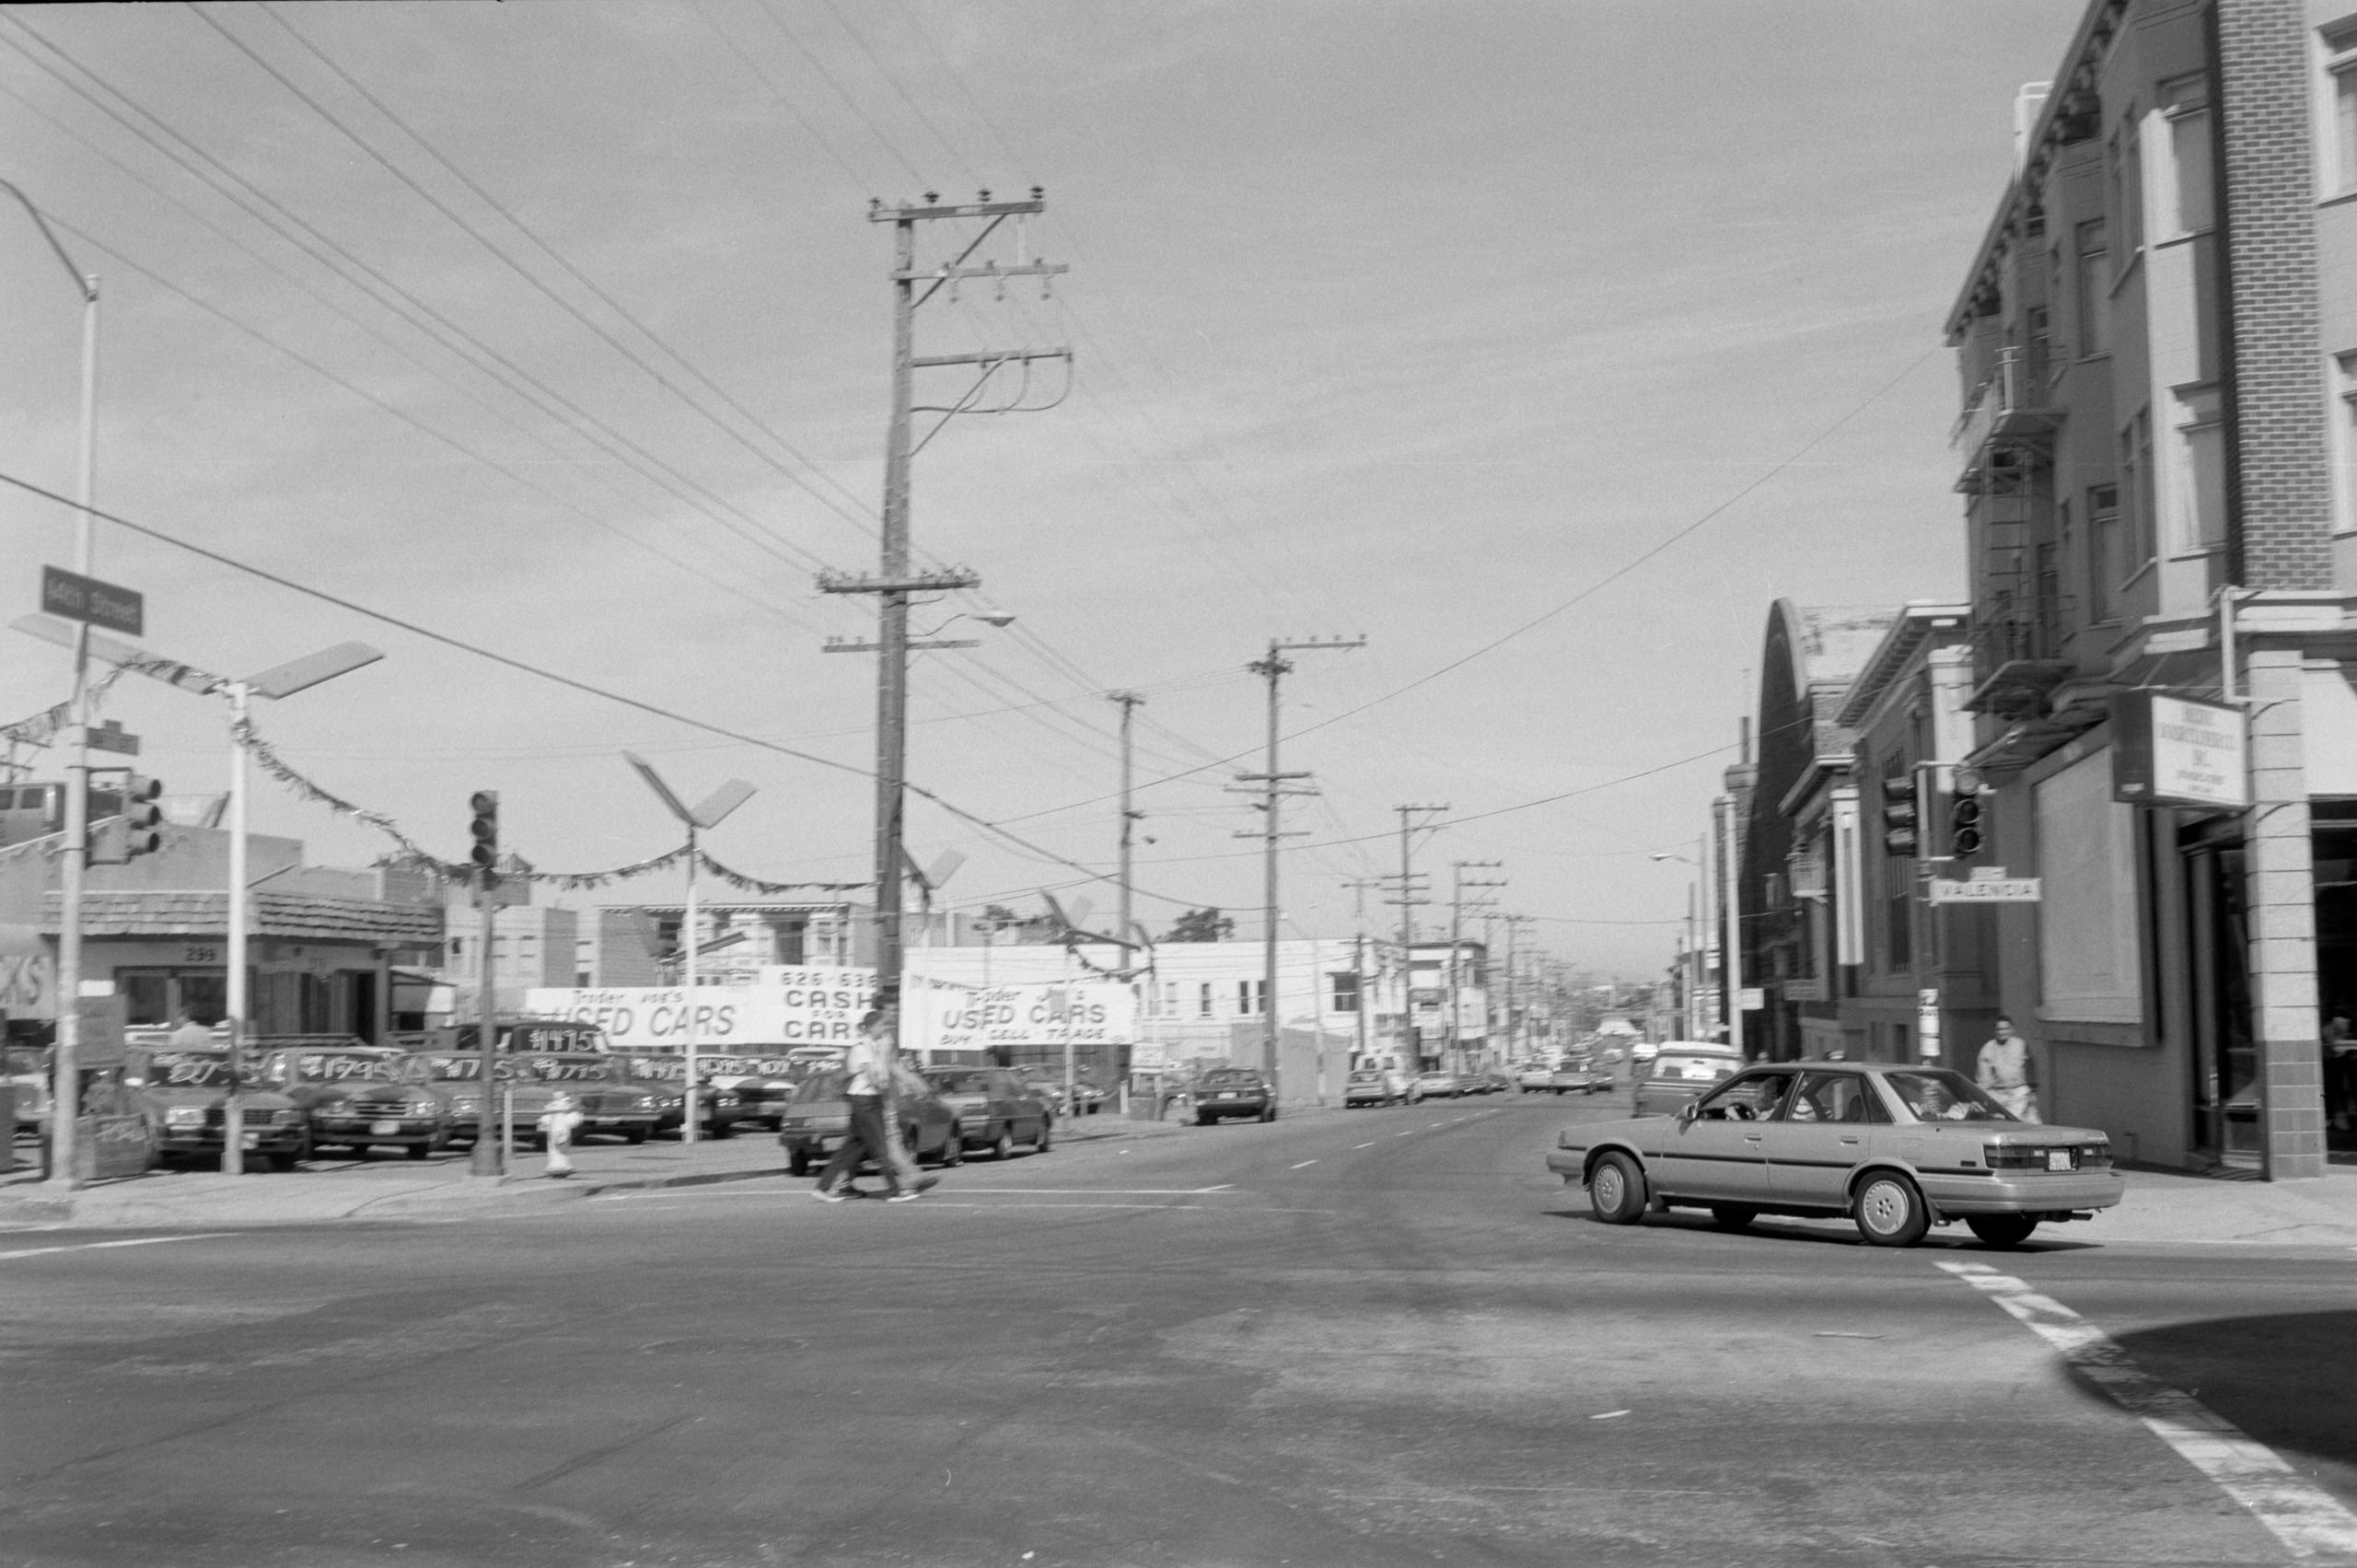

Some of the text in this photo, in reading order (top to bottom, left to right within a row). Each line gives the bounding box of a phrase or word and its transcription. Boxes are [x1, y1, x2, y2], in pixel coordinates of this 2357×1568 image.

[1942, 883, 2033, 897] VALENCIA
[785, 989, 876, 1010] CASH
[650, 1005, 736, 1037] CARS
[942, 1004, 1106, 1029] USED CARS
[784, 1020, 864, 1040] CAR
[446, 1059, 515, 1078] $175
